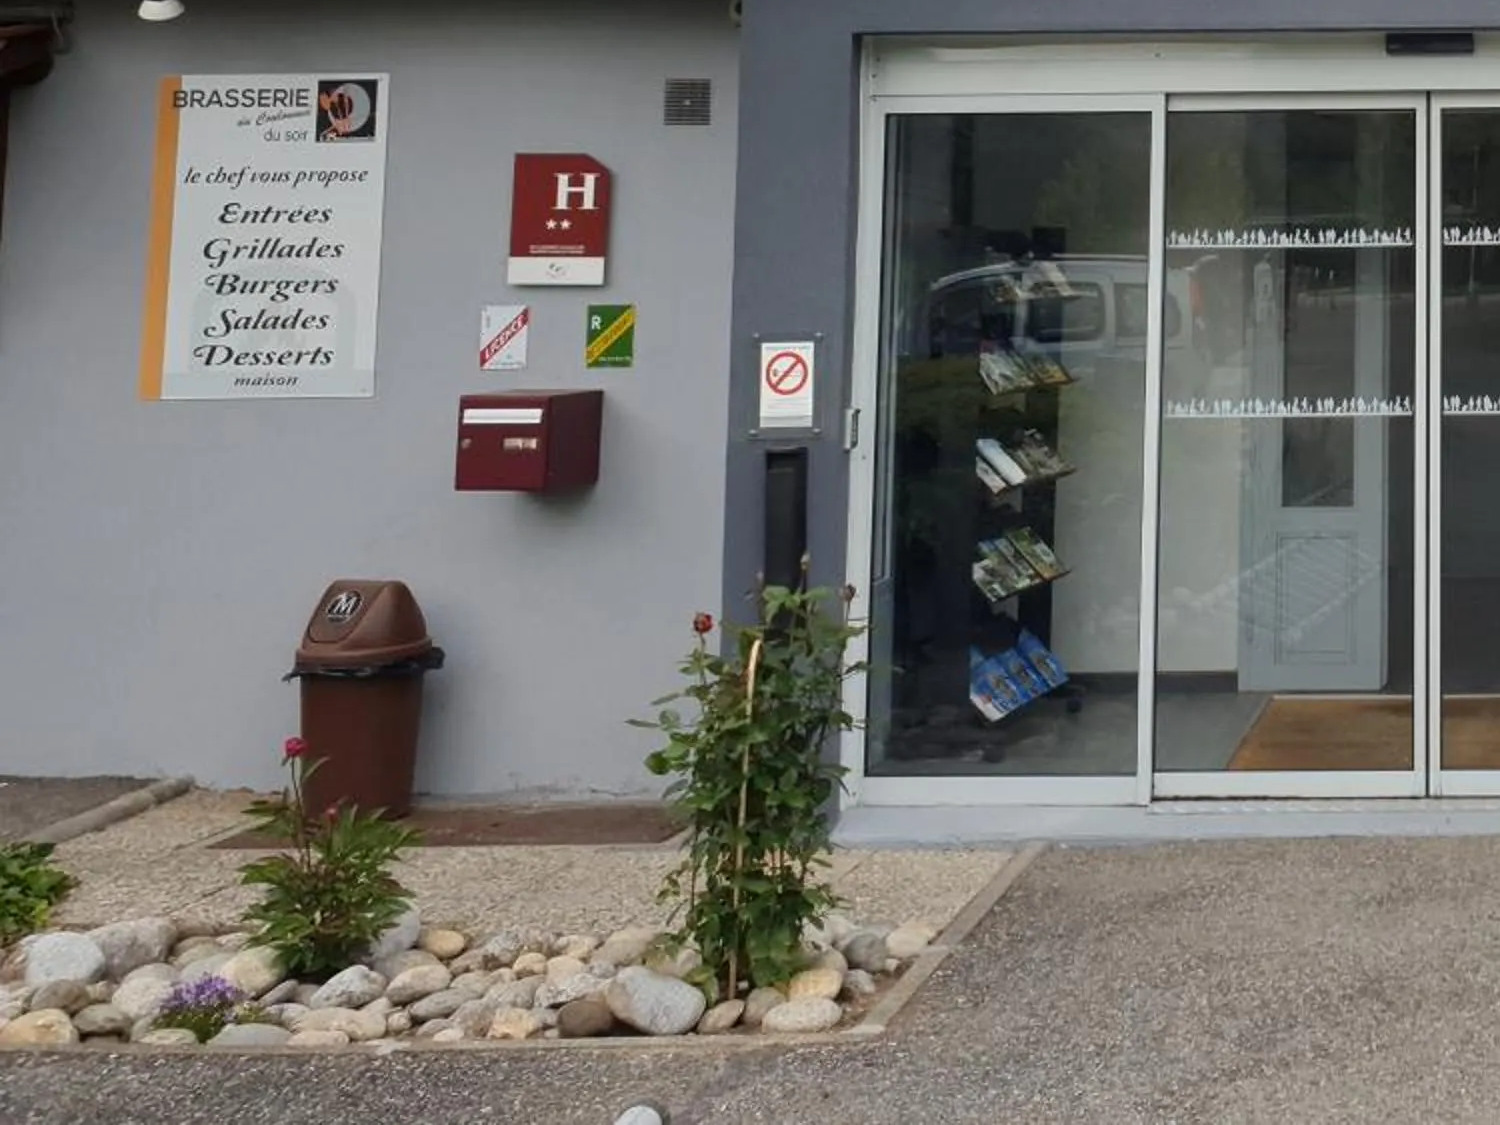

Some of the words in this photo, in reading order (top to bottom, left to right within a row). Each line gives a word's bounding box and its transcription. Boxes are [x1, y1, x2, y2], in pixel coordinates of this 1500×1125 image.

[172, 88, 311, 108] BRASSERIE
[263, 128, 281, 142] du
[184, 166, 202, 184] le
[204, 165, 250, 190] chef
[250, 170, 291, 184] vous
[292, 169, 369, 188] propose
[552, 172, 601, 210] H
[203, 237, 345, 269] Grillades
[204, 273, 340, 302] Burgers
[203, 307, 331, 338] Salades
[591, 314, 603, 330] R
[193, 343, 335, 367] Desserts
[234, 373, 299, 387] maison
